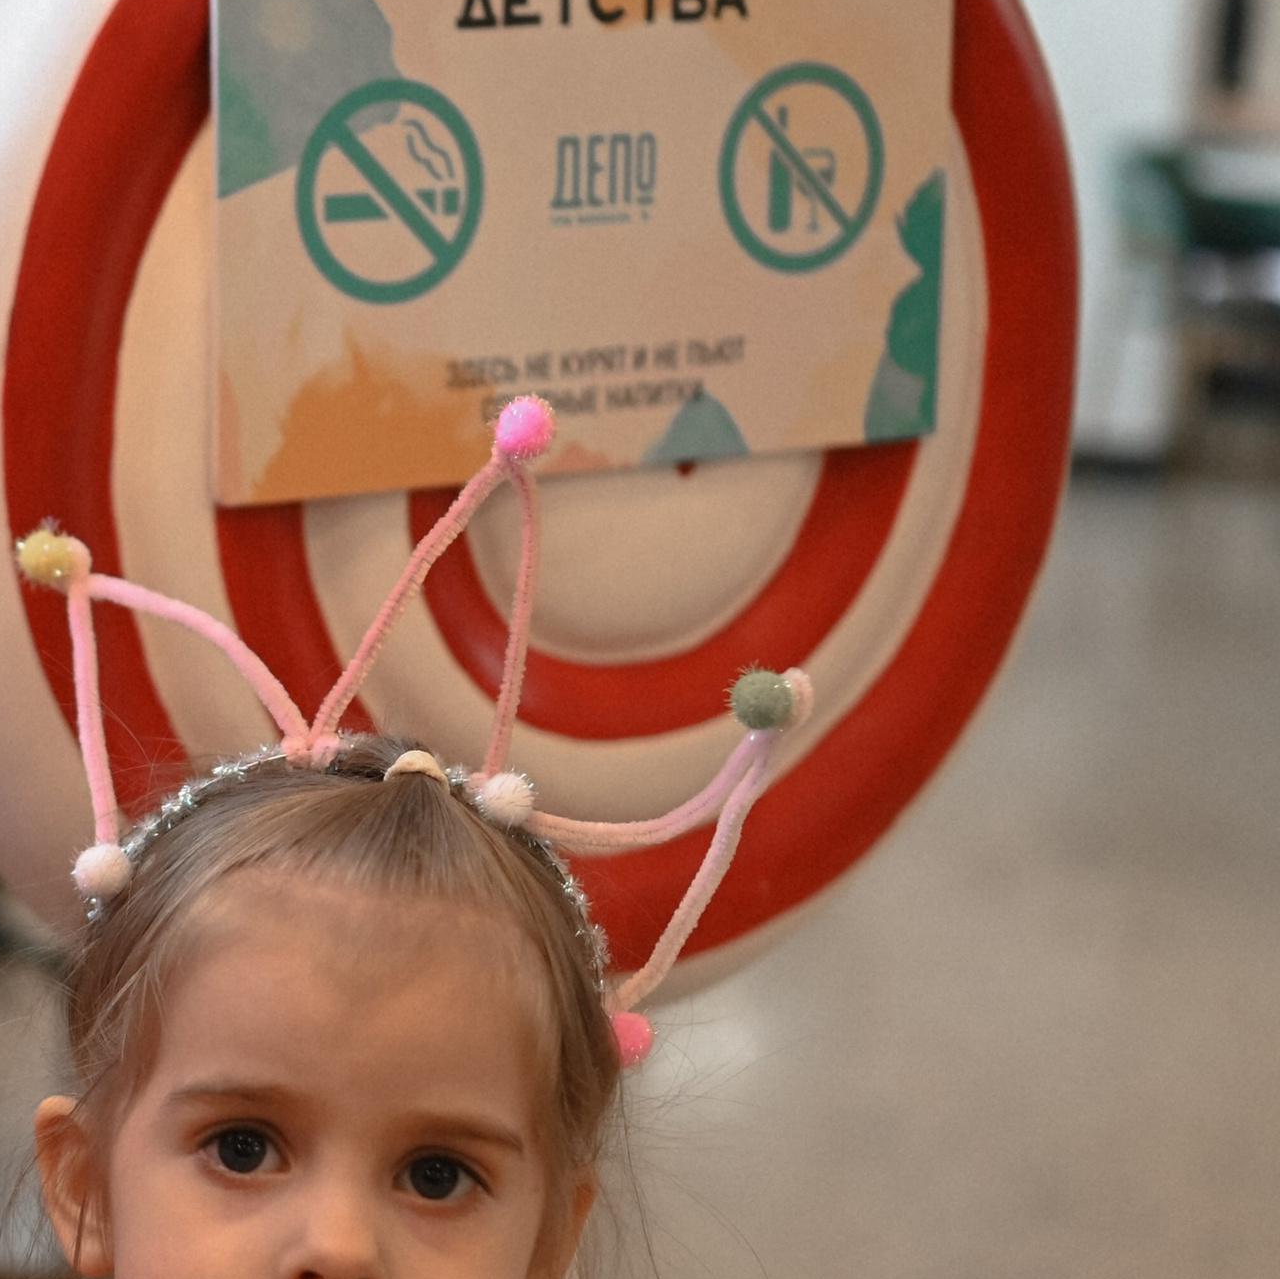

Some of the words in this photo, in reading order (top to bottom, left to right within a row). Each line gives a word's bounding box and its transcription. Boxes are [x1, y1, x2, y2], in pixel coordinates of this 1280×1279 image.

[550, 131, 657, 209] ДЕПО
[446, 354, 518, 389] ЗДЕСЬ
[524, 350, 552, 381] НЕ
[559, 343, 626, 378] КУРЯТ
[633, 341, 648, 371] И
[653, 337, 679, 369] НЕ
